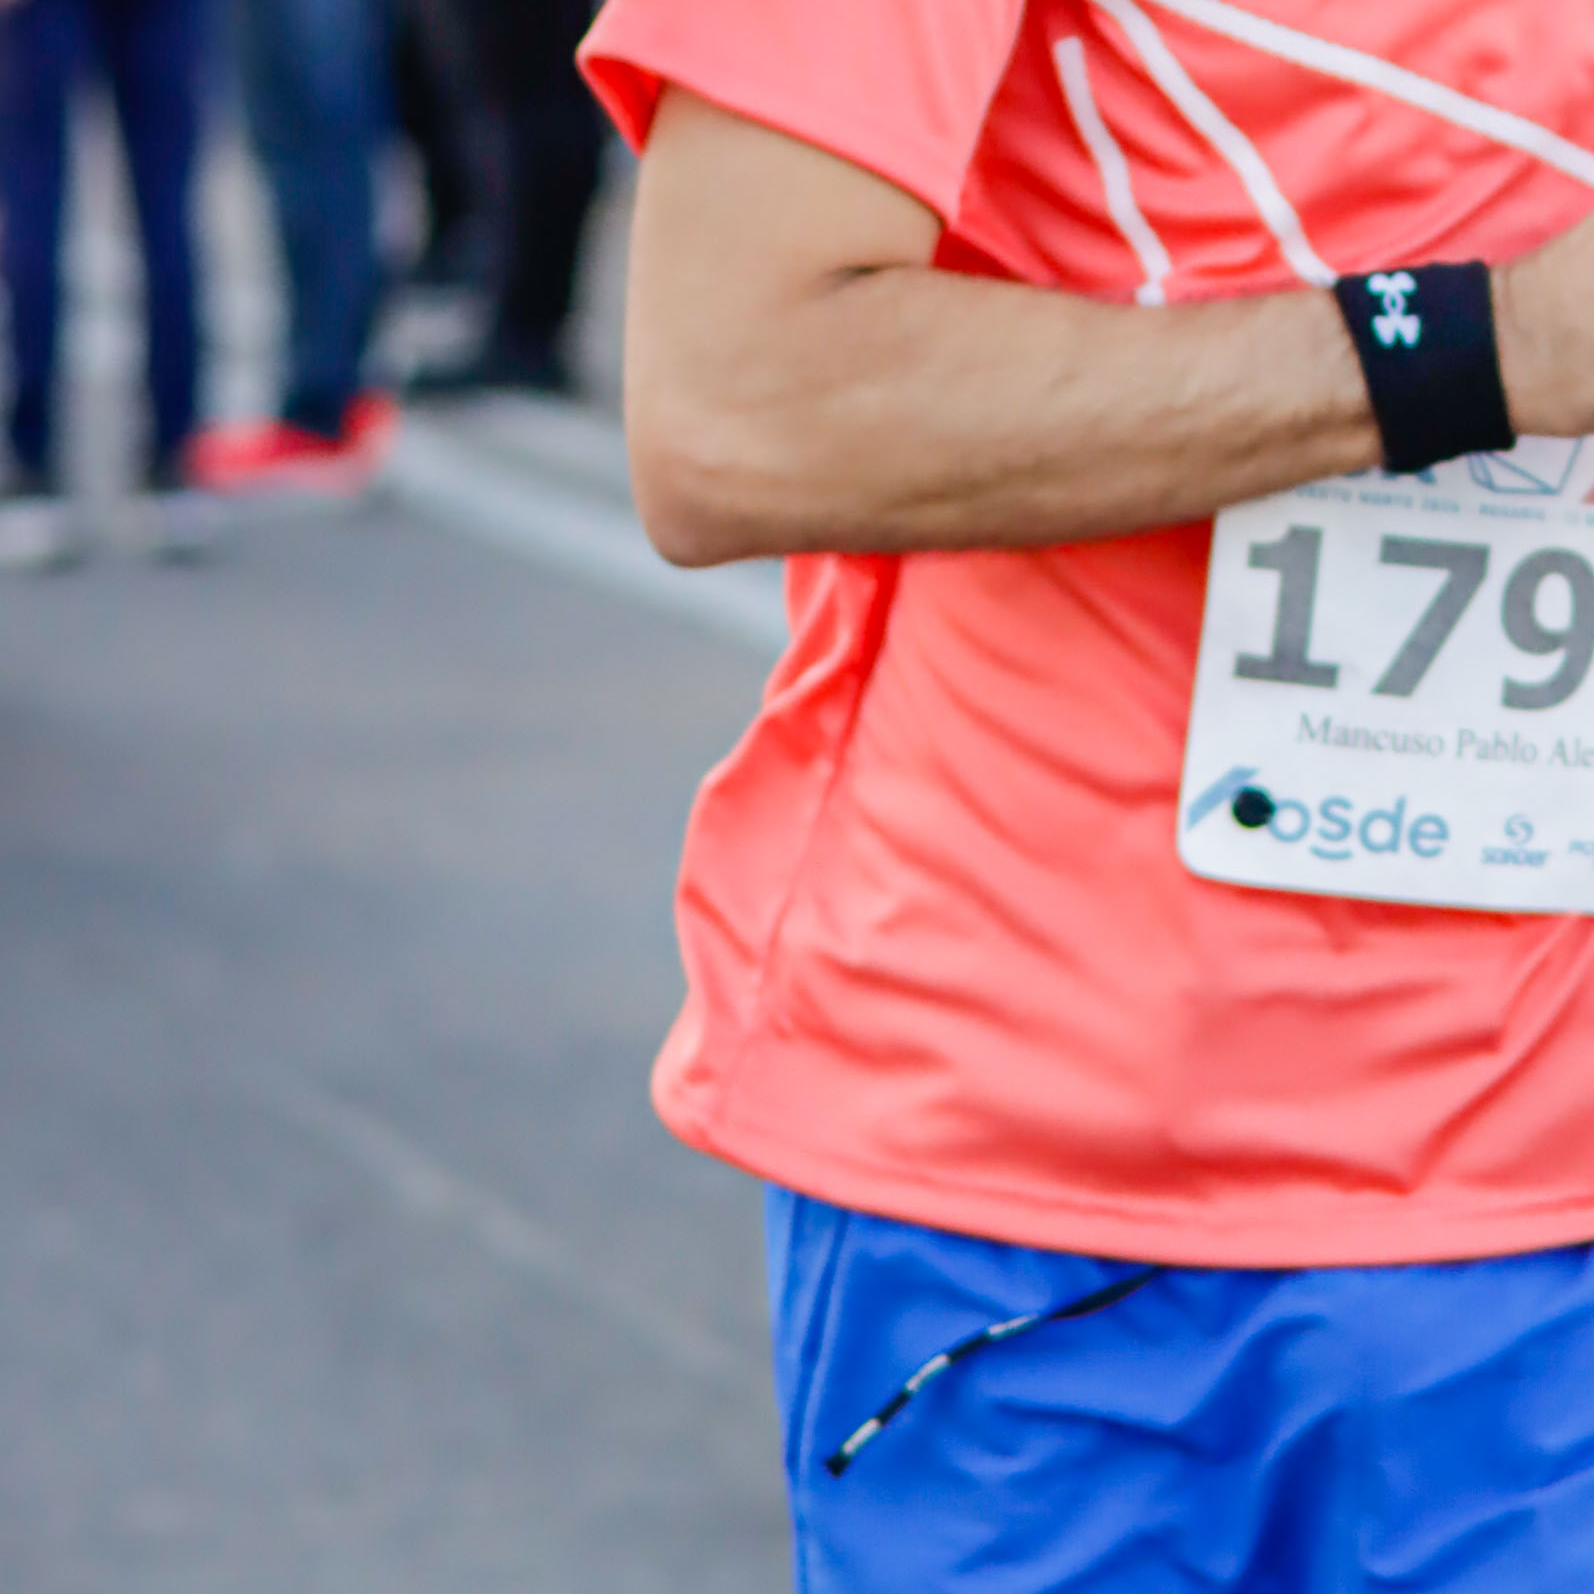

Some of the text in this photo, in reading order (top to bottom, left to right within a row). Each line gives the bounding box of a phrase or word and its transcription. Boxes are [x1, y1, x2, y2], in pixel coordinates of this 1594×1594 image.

[1296, 712, 1445, 757] Mancuso
[1455, 727, 1538, 765] Pablo
[1268, 794, 1450, 858] osde
